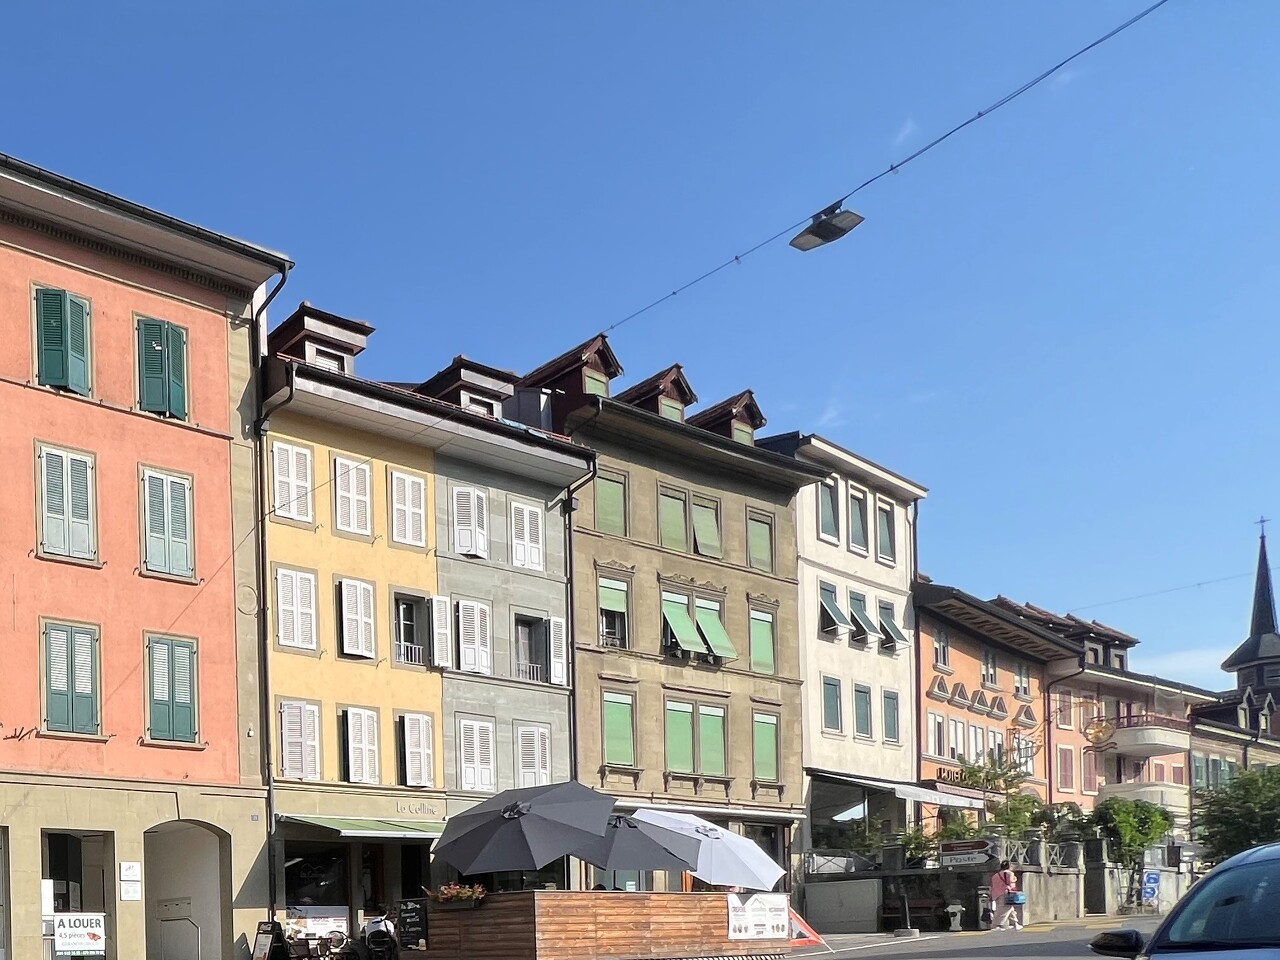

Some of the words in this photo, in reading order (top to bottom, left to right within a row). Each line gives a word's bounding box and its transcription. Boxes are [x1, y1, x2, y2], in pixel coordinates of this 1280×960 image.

[409, 803, 437, 815] Colline
[57, 918, 66, 928] A
[68, 918, 102, 928] LOUER
